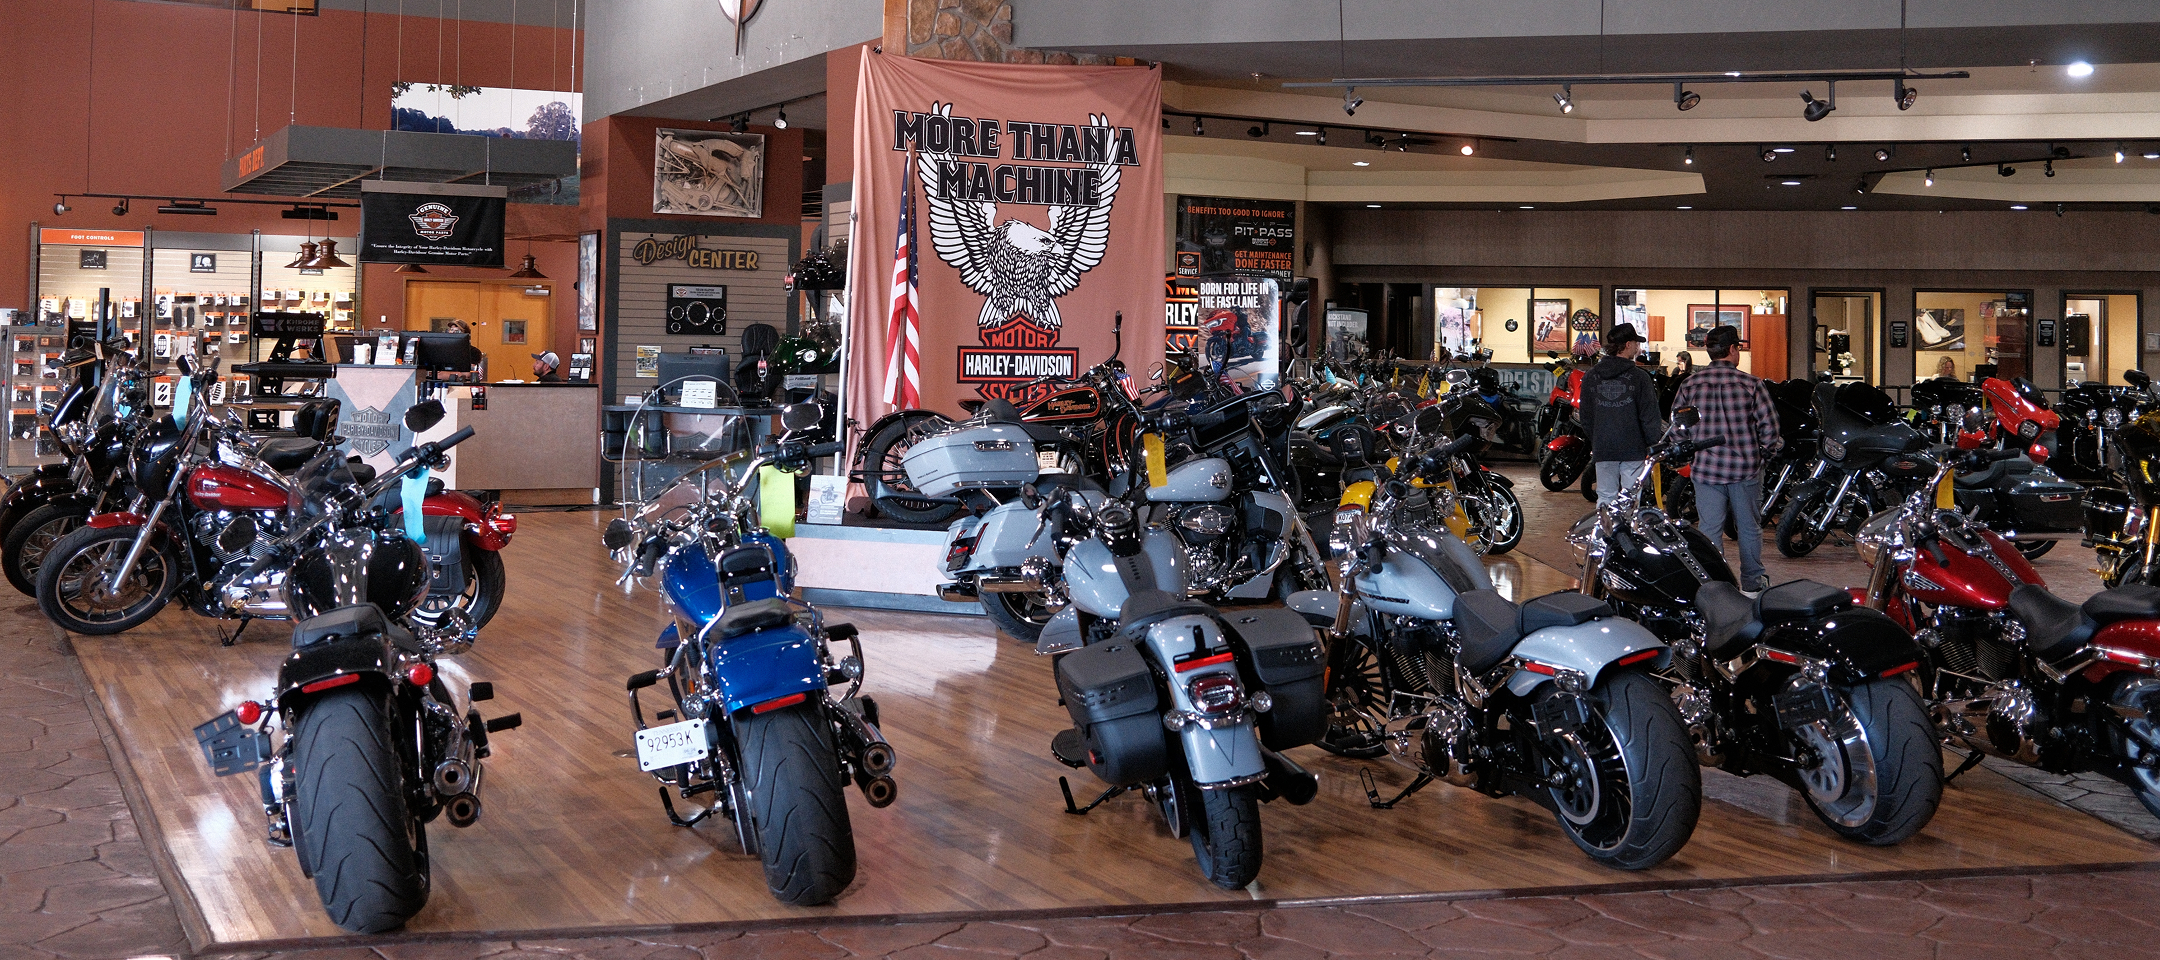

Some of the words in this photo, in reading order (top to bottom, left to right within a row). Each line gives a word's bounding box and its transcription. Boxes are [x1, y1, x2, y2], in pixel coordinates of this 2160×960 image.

[892, 109, 1001, 159] MORE
[1007, 120, 1110, 166] THAN
[1111, 126, 1141, 167] A
[935, 160, 1102, 207] MACHINE
[419, 204, 449, 214] GENUINE
[1187, 205, 1217, 215] BENEFITS
[1218, 207, 1231, 216] TOO
[1232, 208, 1251, 217] GOOD
[1251, 209, 1260, 217] TO
[1261, 210, 1285, 218] IGNORE
[1234, 226, 1255, 236] PIT
[1259, 227, 1293, 238] PASS
[633, 234, 697, 265] Design
[688, 248, 759, 271] CENTER
[1234, 250, 1247, 258] GET
[1249, 251, 1292, 260] MAINTENANCE
[1178, 267, 1198, 275] SERVICE
[1235, 259, 1259, 269] DONE
[1260, 260, 1292, 270] FASTER
[1200, 282, 1222, 295] BORN
[1223, 283, 1239, 295] FOR
[1241, 283, 1258, 296] LIFE
[1260, 283, 1269, 296] IN
[1200, 296, 1216, 308] THE
[1217, 296, 1234, 308] FAST
[1239, 296, 1261, 309] LANE.
[991, 323, 1049, 347] MOTOR
[965, 354, 1072, 376] HARLEY-DAVIDSON
[353, 410, 384, 423] MOTOR
[343, 424, 397, 440] HARLEY-DAVIDSON
[350, 439, 383, 453] CYCLES
[647, 730, 693, 753] 92953K
